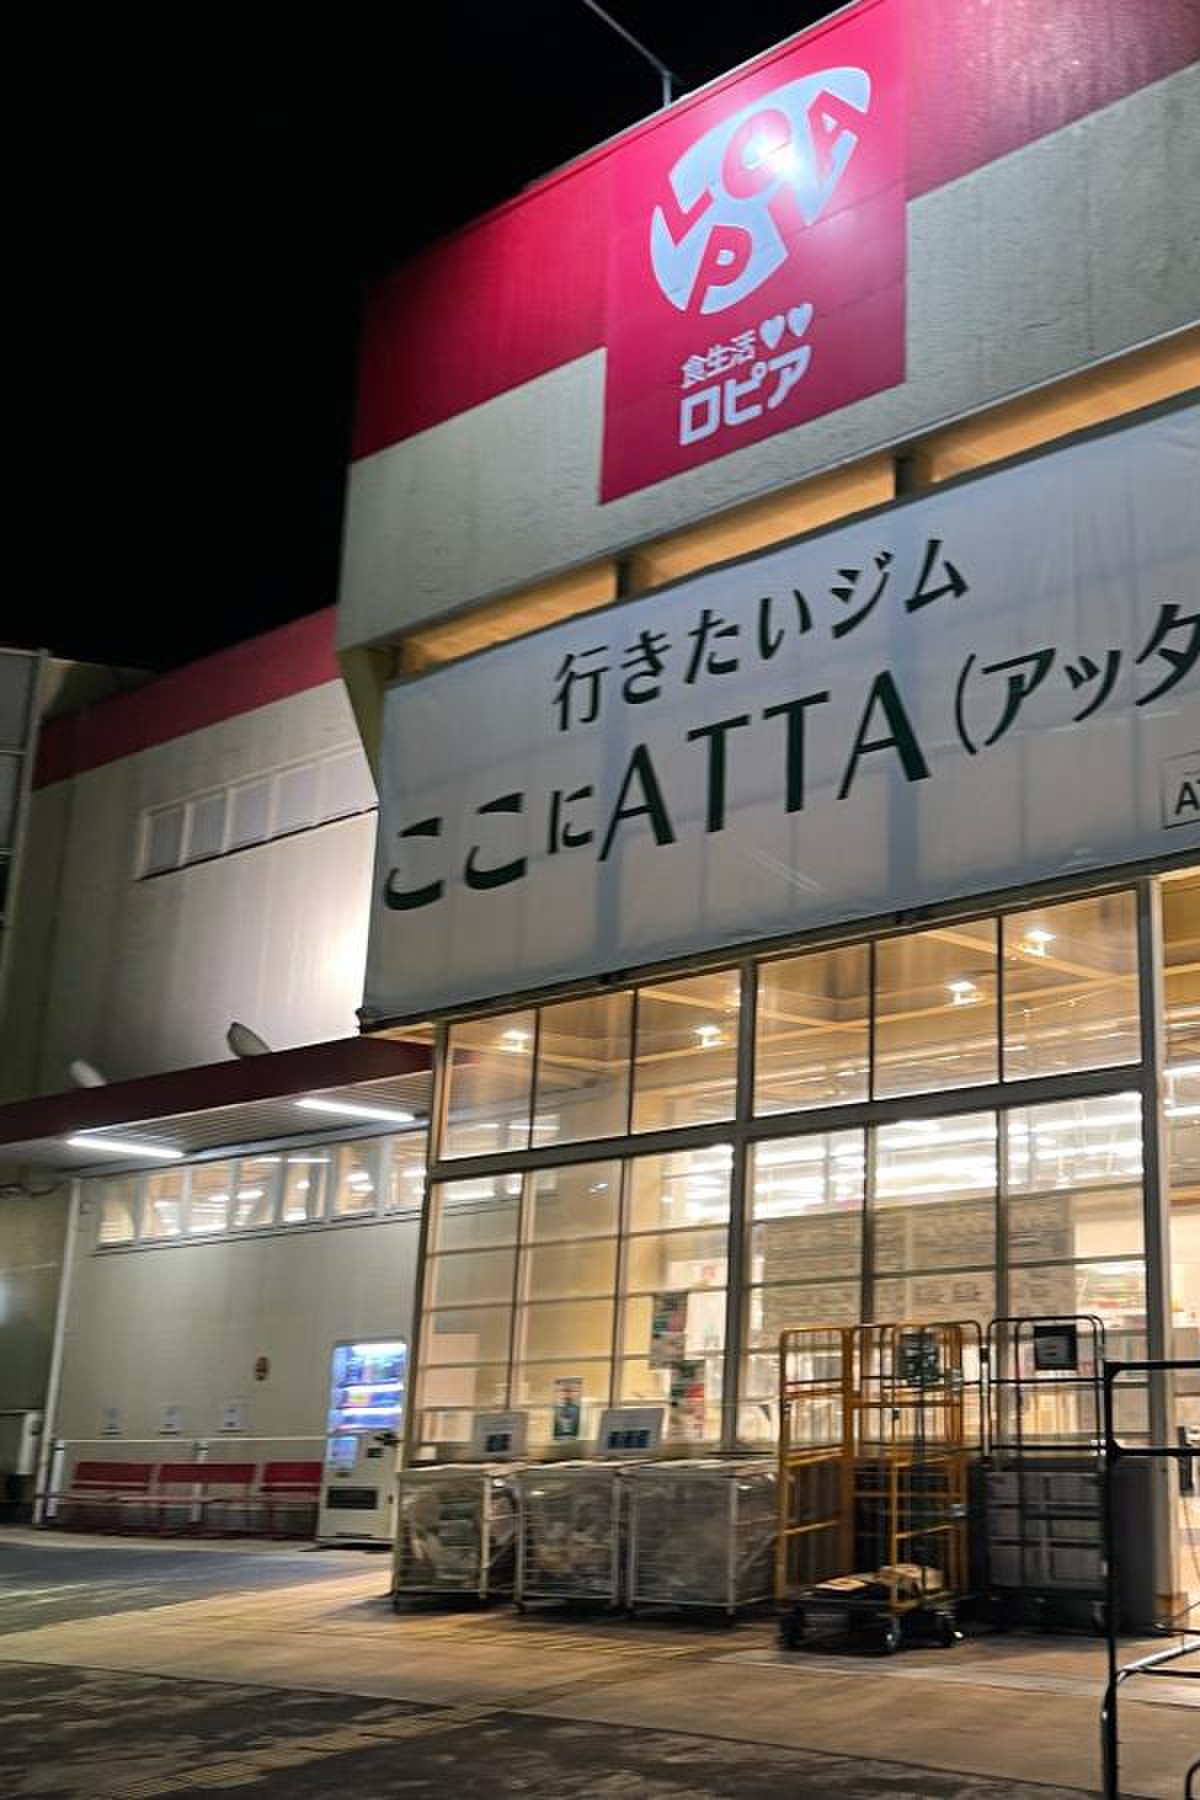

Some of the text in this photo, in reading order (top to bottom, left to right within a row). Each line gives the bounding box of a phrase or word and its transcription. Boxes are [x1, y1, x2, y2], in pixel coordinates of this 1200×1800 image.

[680, 329, 756, 390] 食生活
[680, 344, 811, 446] ロピア
[552, 538, 970, 732] 行きたいジム
